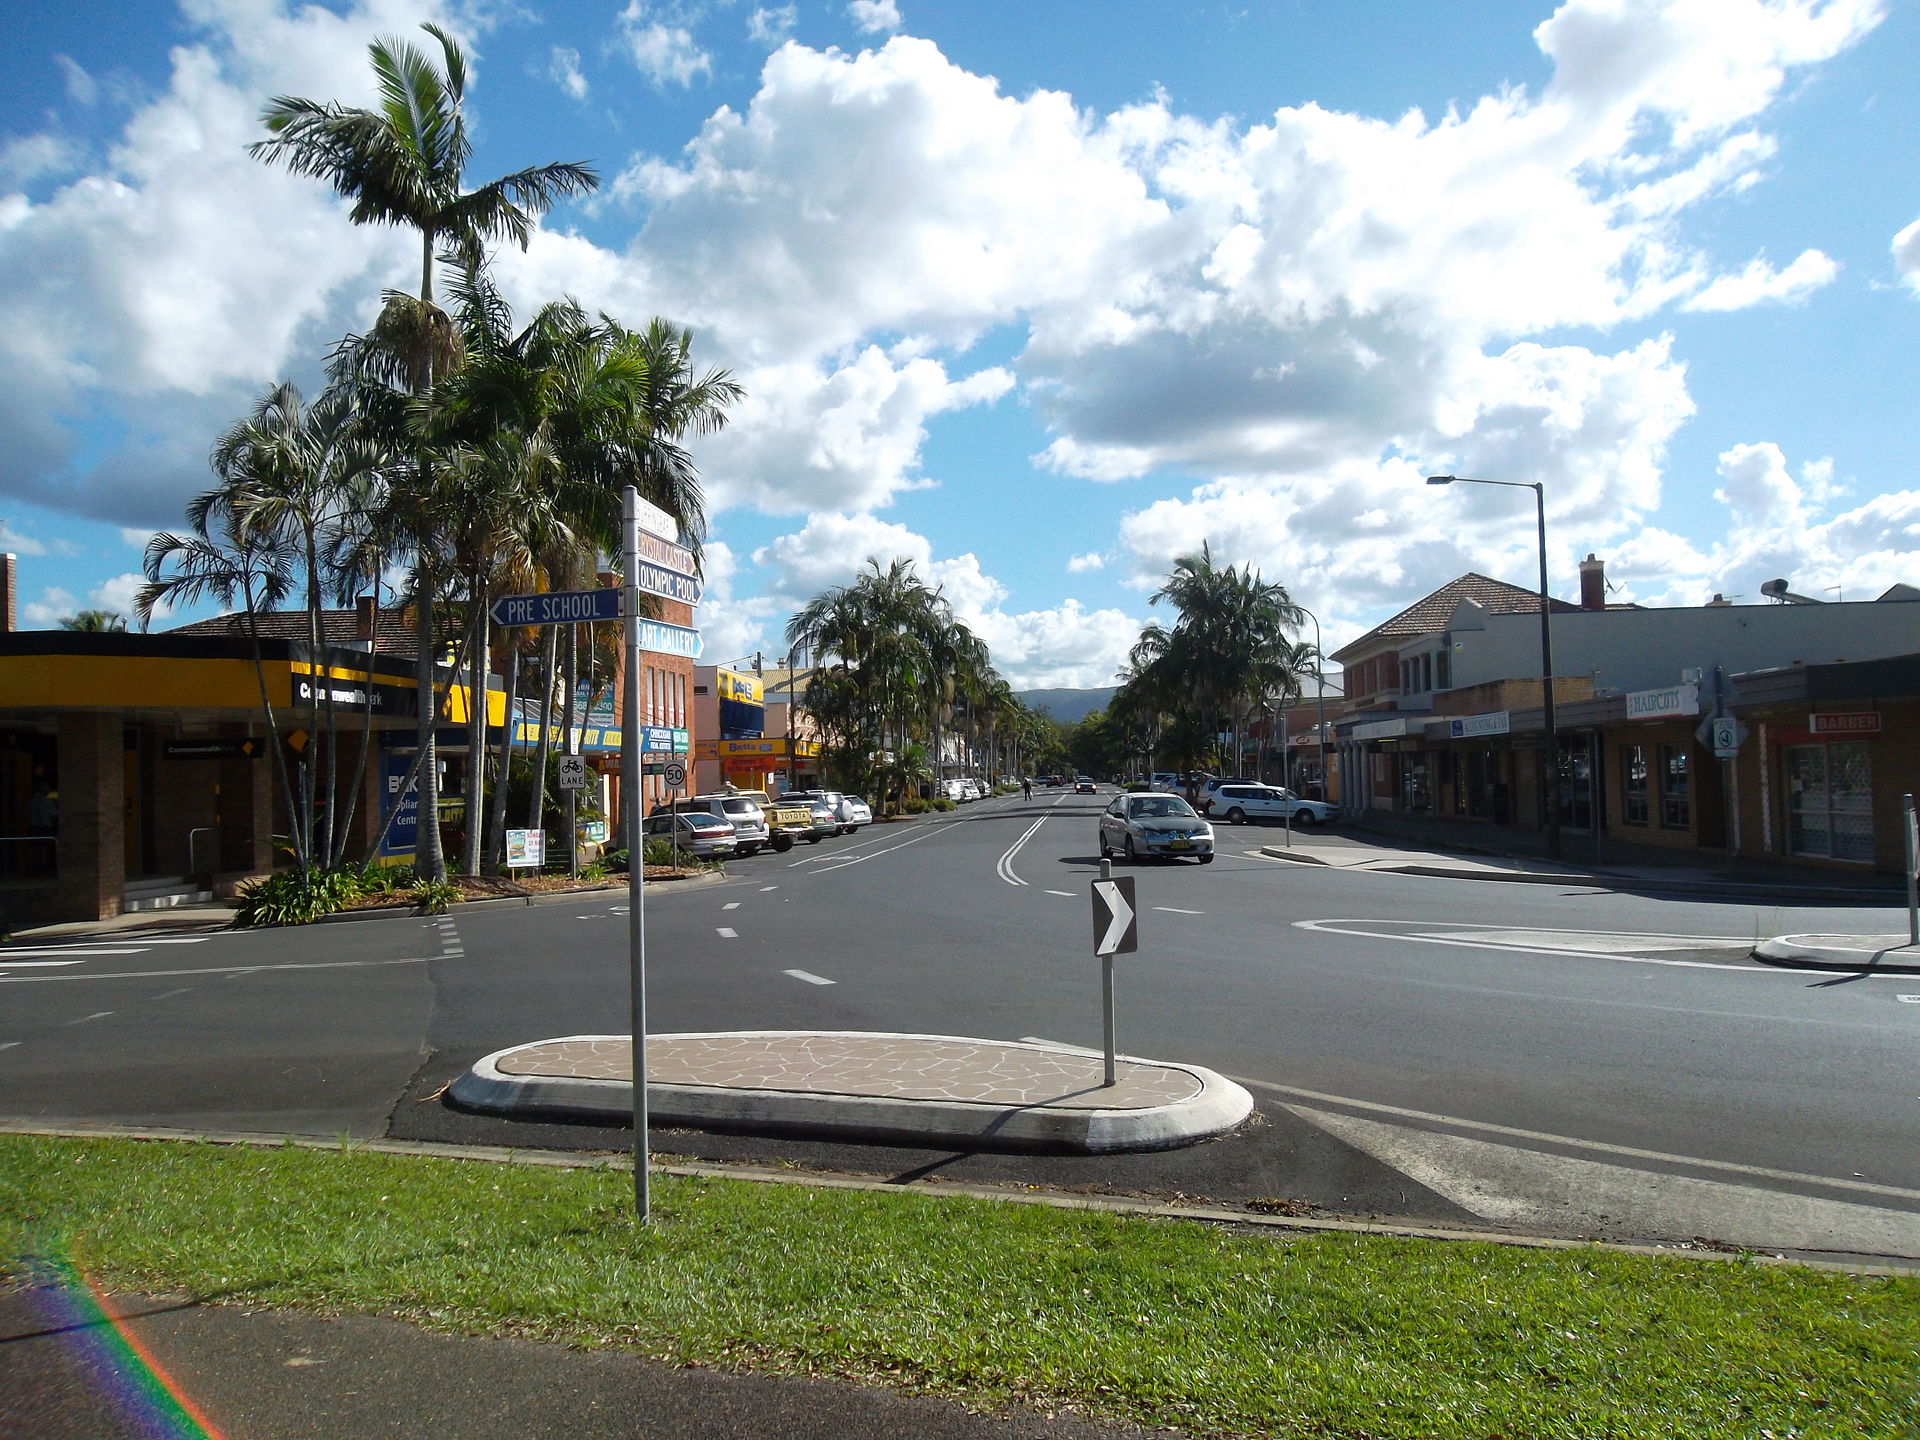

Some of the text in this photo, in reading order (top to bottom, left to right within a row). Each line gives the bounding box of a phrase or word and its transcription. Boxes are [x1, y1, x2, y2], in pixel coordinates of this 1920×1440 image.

[665, 545, 688, 573] CASTLE
[641, 564, 697, 602] OLYMPIC POOL
[508, 595, 600, 622] PRE SCHOOL
[641, 624, 695, 656] ART GALLERY
[1634, 691, 1680, 712] HAIRCUTS
[1816, 716, 1877, 729] BARBER
[561, 776, 583, 785] LANE
[667, 769, 682, 780] 50
[780, 812, 807, 820] TOYOTA
